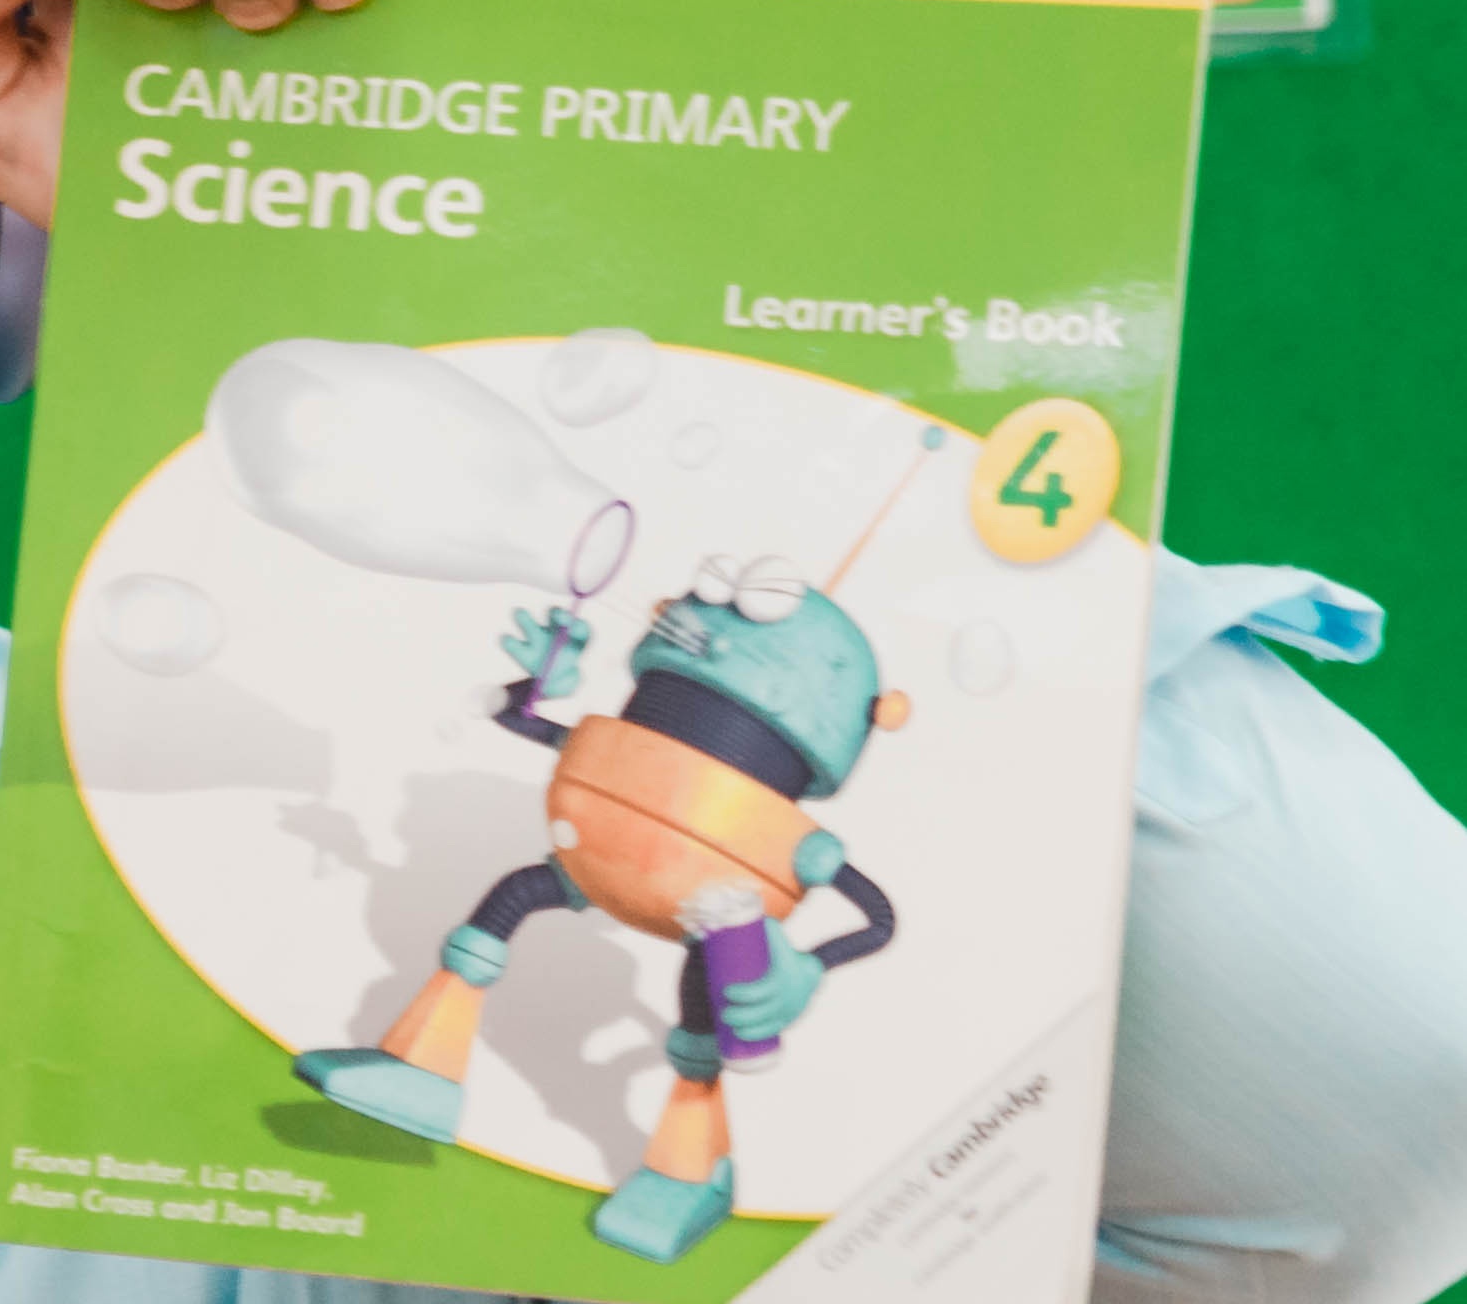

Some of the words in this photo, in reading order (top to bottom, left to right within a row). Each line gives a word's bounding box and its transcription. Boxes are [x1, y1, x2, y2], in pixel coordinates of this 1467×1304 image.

[123, 64, 523, 137] CAMBRIDGE
[541, 85, 851, 153] PRIMARY
[114, 138, 486, 238] Science
[723, 284, 971, 341] Learner's
[985, 299, 1125, 348] Book
[999, 430, 1073, 528] 4
[12, 1146, 91, 1177] Fiona
[199, 1164, 238, 1192] Liz
[929, 1074, 1050, 1179] Cambridge
[9, 1182, 77, 1209] Alan
[81, 1188, 154, 1217] Cross
[160, 1195, 217, 1225] and
[276, 1205, 365, 1238] Board
